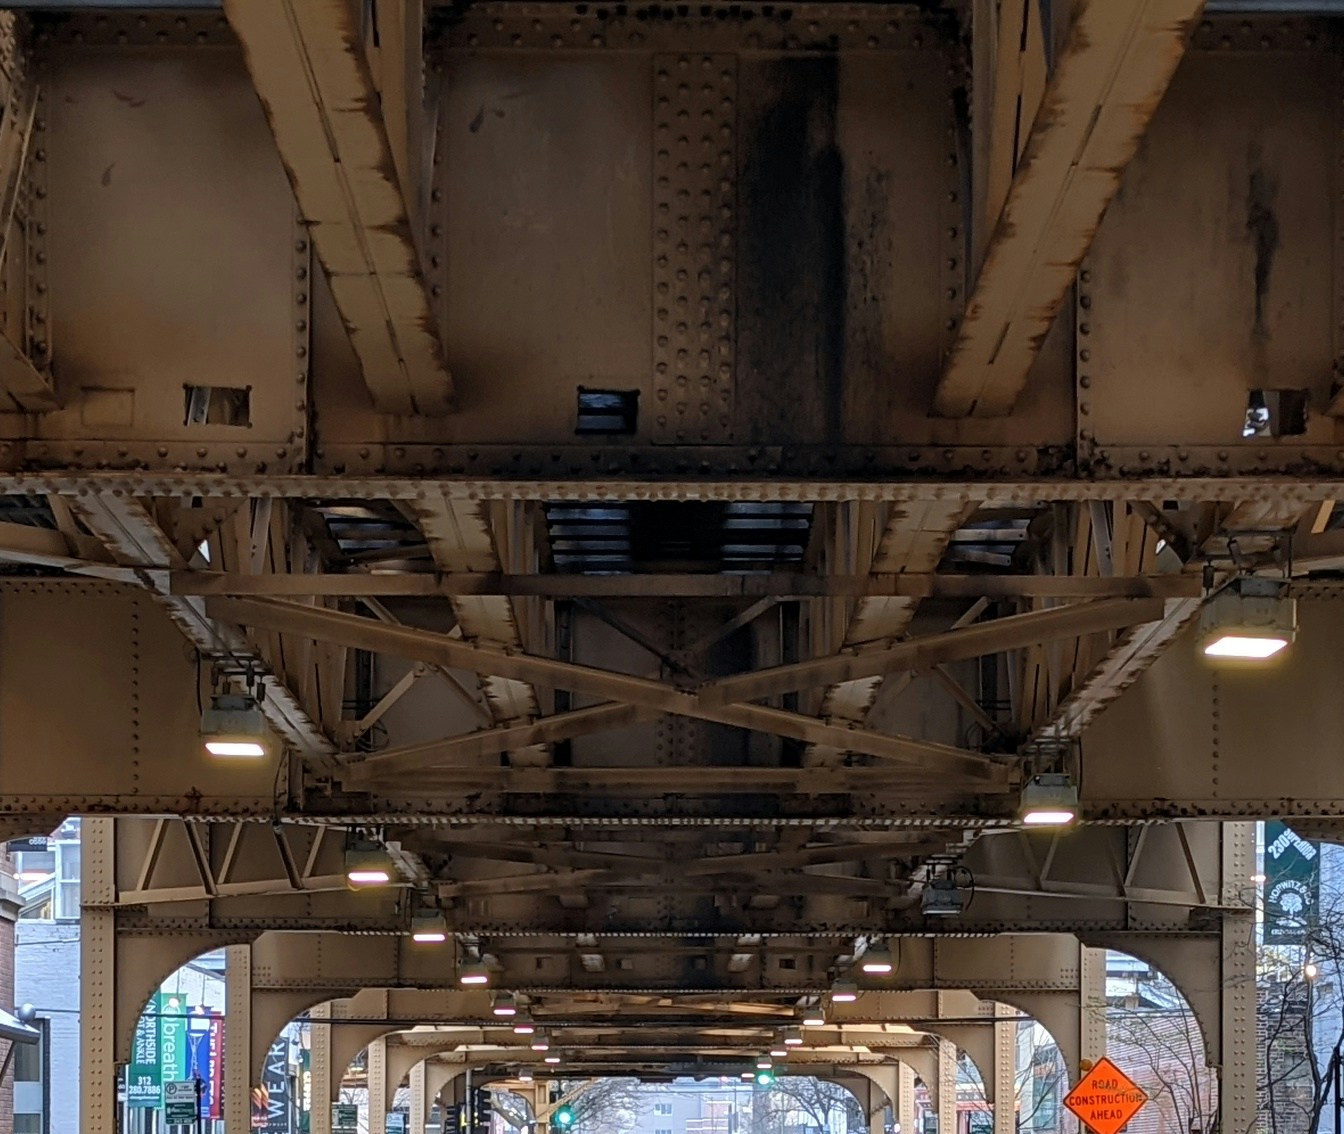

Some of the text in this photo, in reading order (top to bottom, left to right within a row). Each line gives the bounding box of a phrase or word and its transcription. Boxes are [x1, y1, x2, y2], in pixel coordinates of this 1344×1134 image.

[1267, 833, 1292, 860] 230
[1091, 1079, 1119, 1090] ROAD
[1069, 1092, 1143, 1107] CONSTRUCTION
[1090, 1109, 1123, 1120] AHEAD
